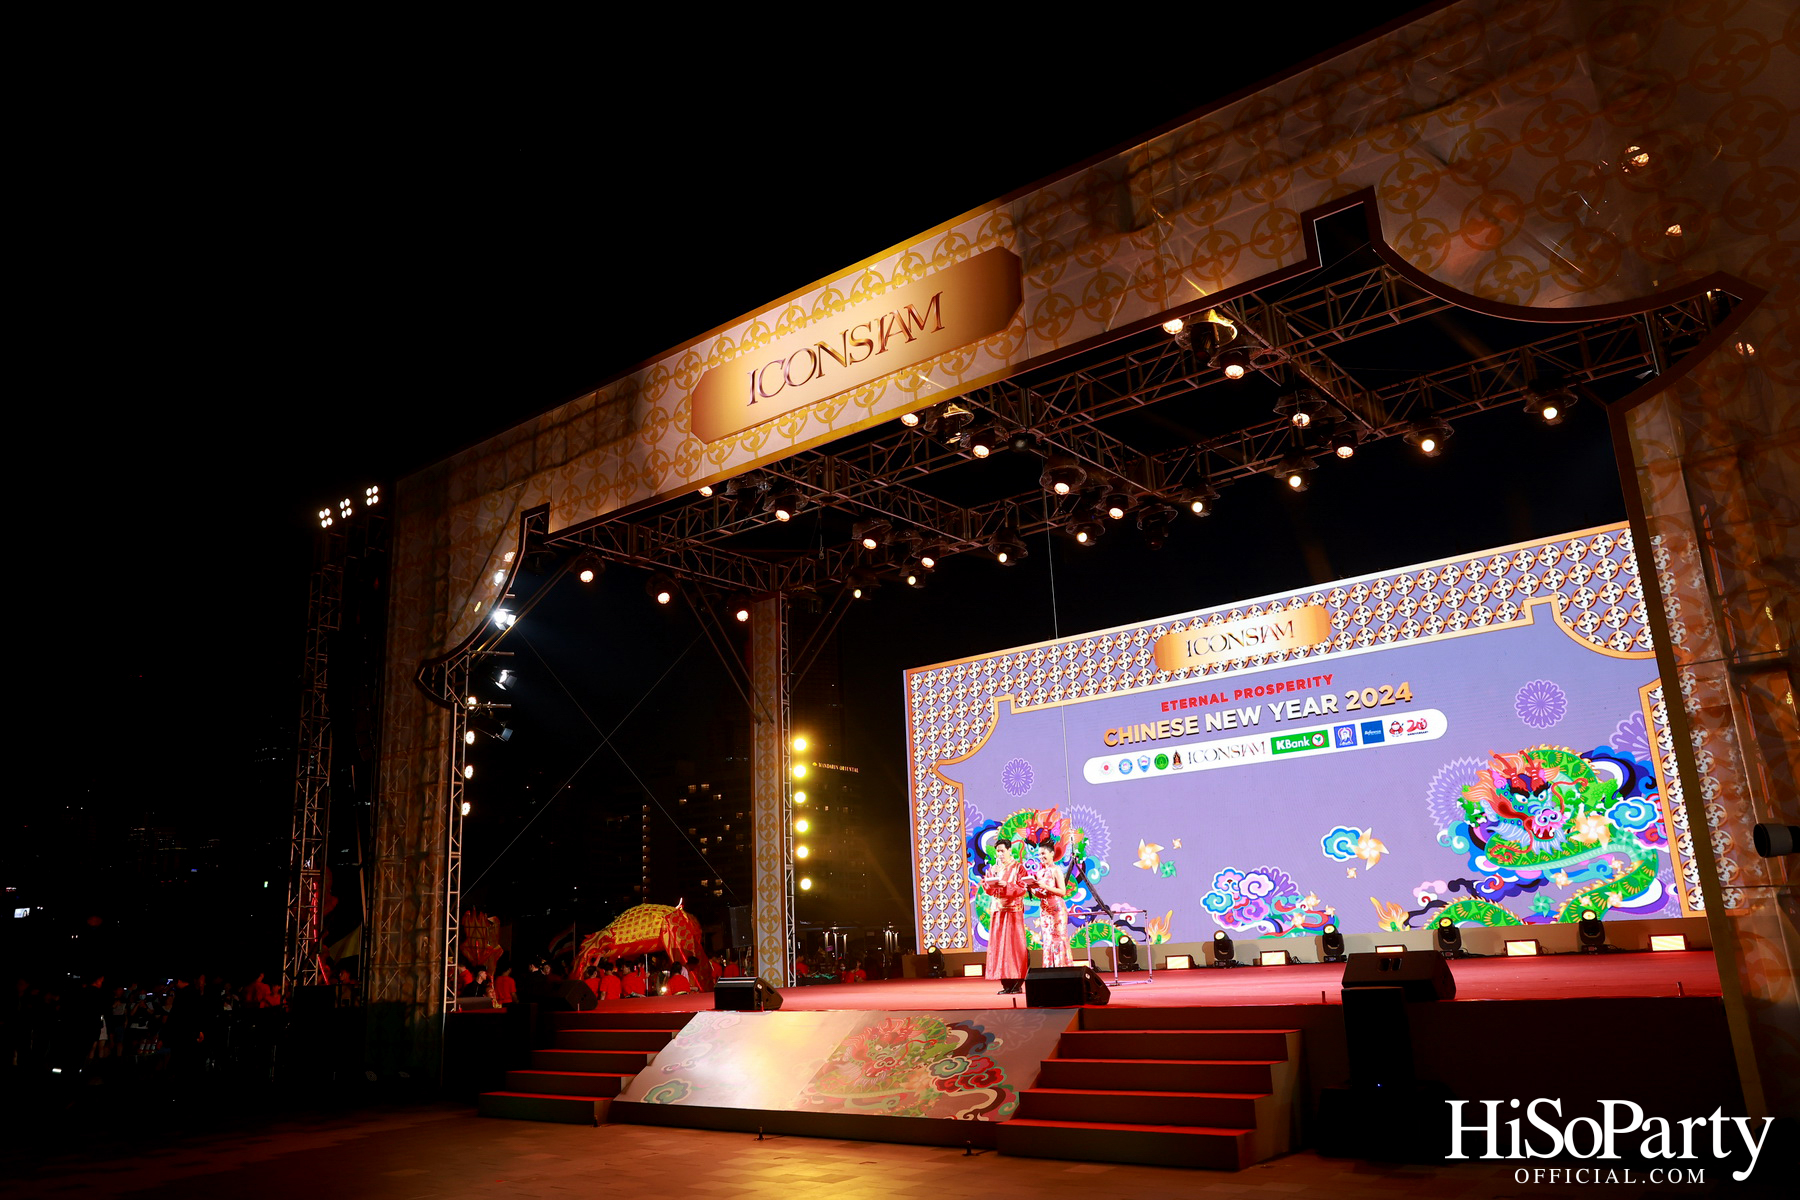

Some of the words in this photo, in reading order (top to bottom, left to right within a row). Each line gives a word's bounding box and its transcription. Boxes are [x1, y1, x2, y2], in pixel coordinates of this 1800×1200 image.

[746, 291, 946, 407] ICONSIAM
[1186, 620, 1295, 658] ICONSIAM
[1161, 692, 1229, 712] ETERNAL
[1234, 674, 1334, 700] PROSPERITY
[1103, 715, 1200, 747] CHINESE
[1205, 704, 1262, 733] NEW
[1268, 694, 1339, 722] YEAR
[1345, 681, 1413, 712] 2024
[1188, 741, 1266, 765] ICONSIAM
[1276, 736, 1311, 751] KBank
